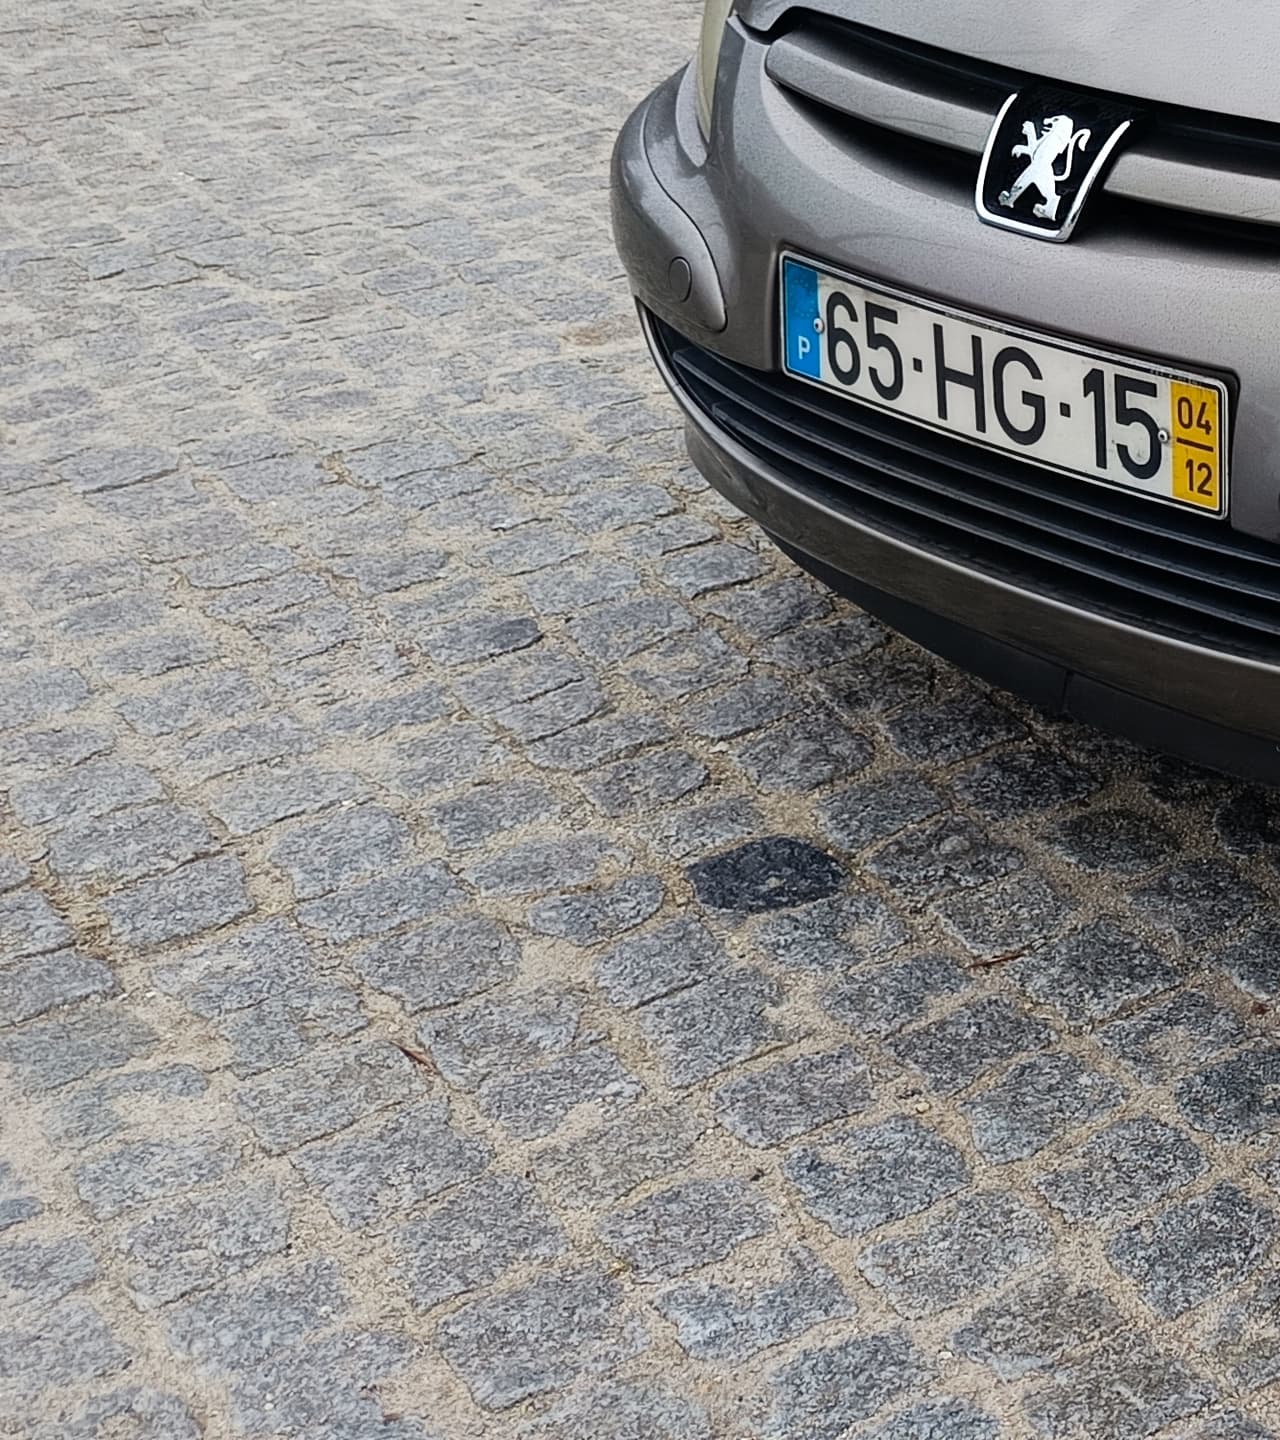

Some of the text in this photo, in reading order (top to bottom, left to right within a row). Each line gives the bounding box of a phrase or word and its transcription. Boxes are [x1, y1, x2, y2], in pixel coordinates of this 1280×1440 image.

[798, 336, 811, 360] P
[1177, 397, 1212, 436] 04
[1185, 459, 1213, 497] 12
